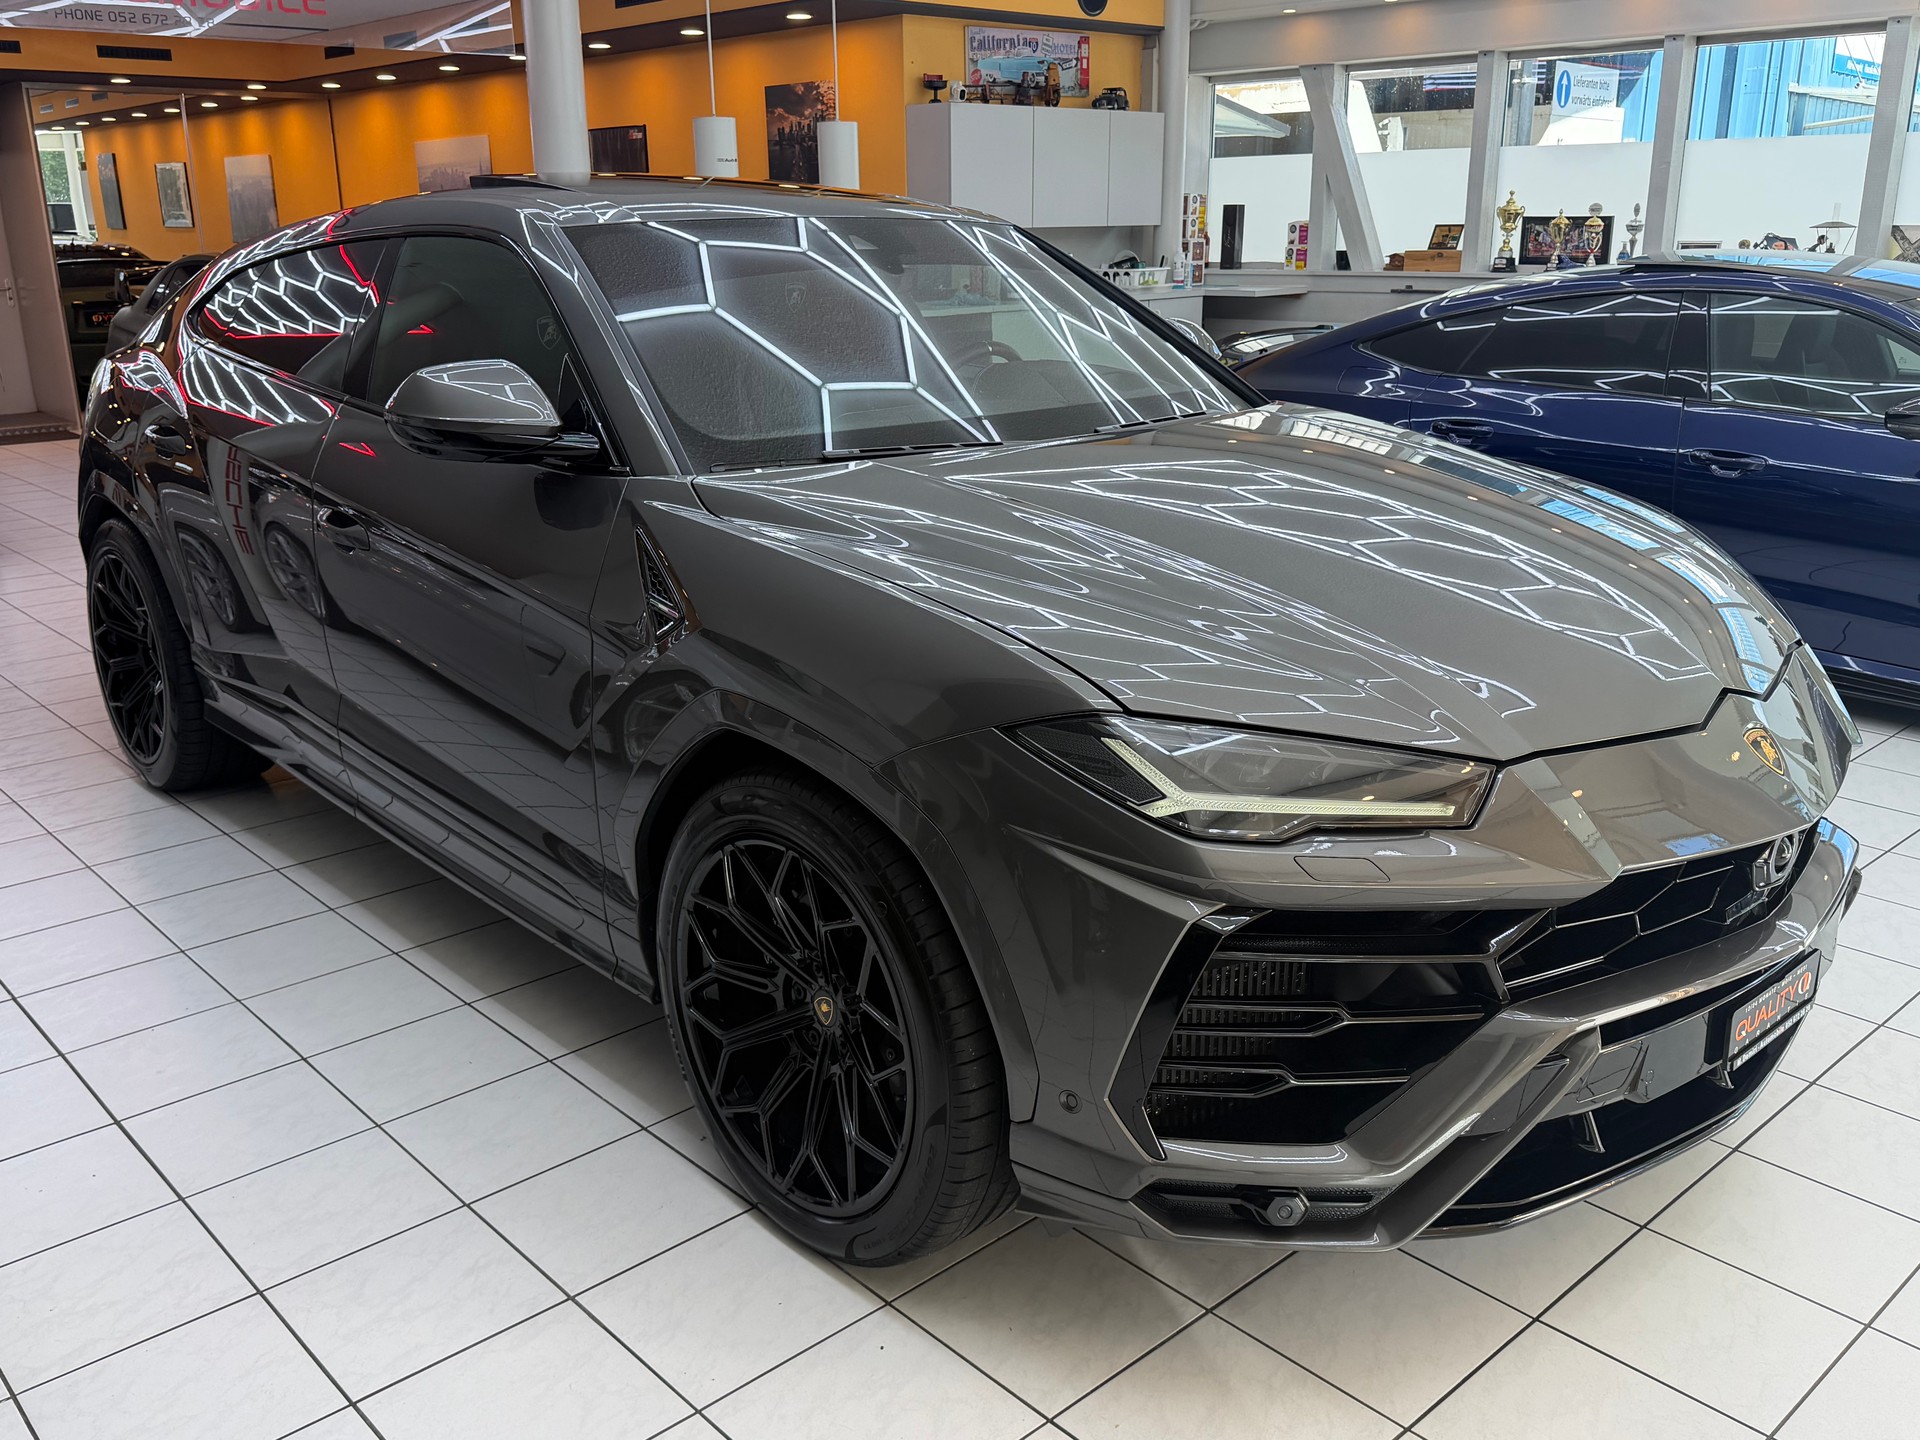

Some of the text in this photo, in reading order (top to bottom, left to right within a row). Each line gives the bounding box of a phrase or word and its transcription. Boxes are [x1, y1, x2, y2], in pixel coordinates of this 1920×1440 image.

[54, 8, 103, 21] PHONE
[107, 11, 137, 24] 052
[142, 13, 168, 26] 672
[970, 34, 1028, 52] California
[1573, 75, 1610, 91] Lieferanten bitte
[1571, 95, 1591, 105] vorwärts
